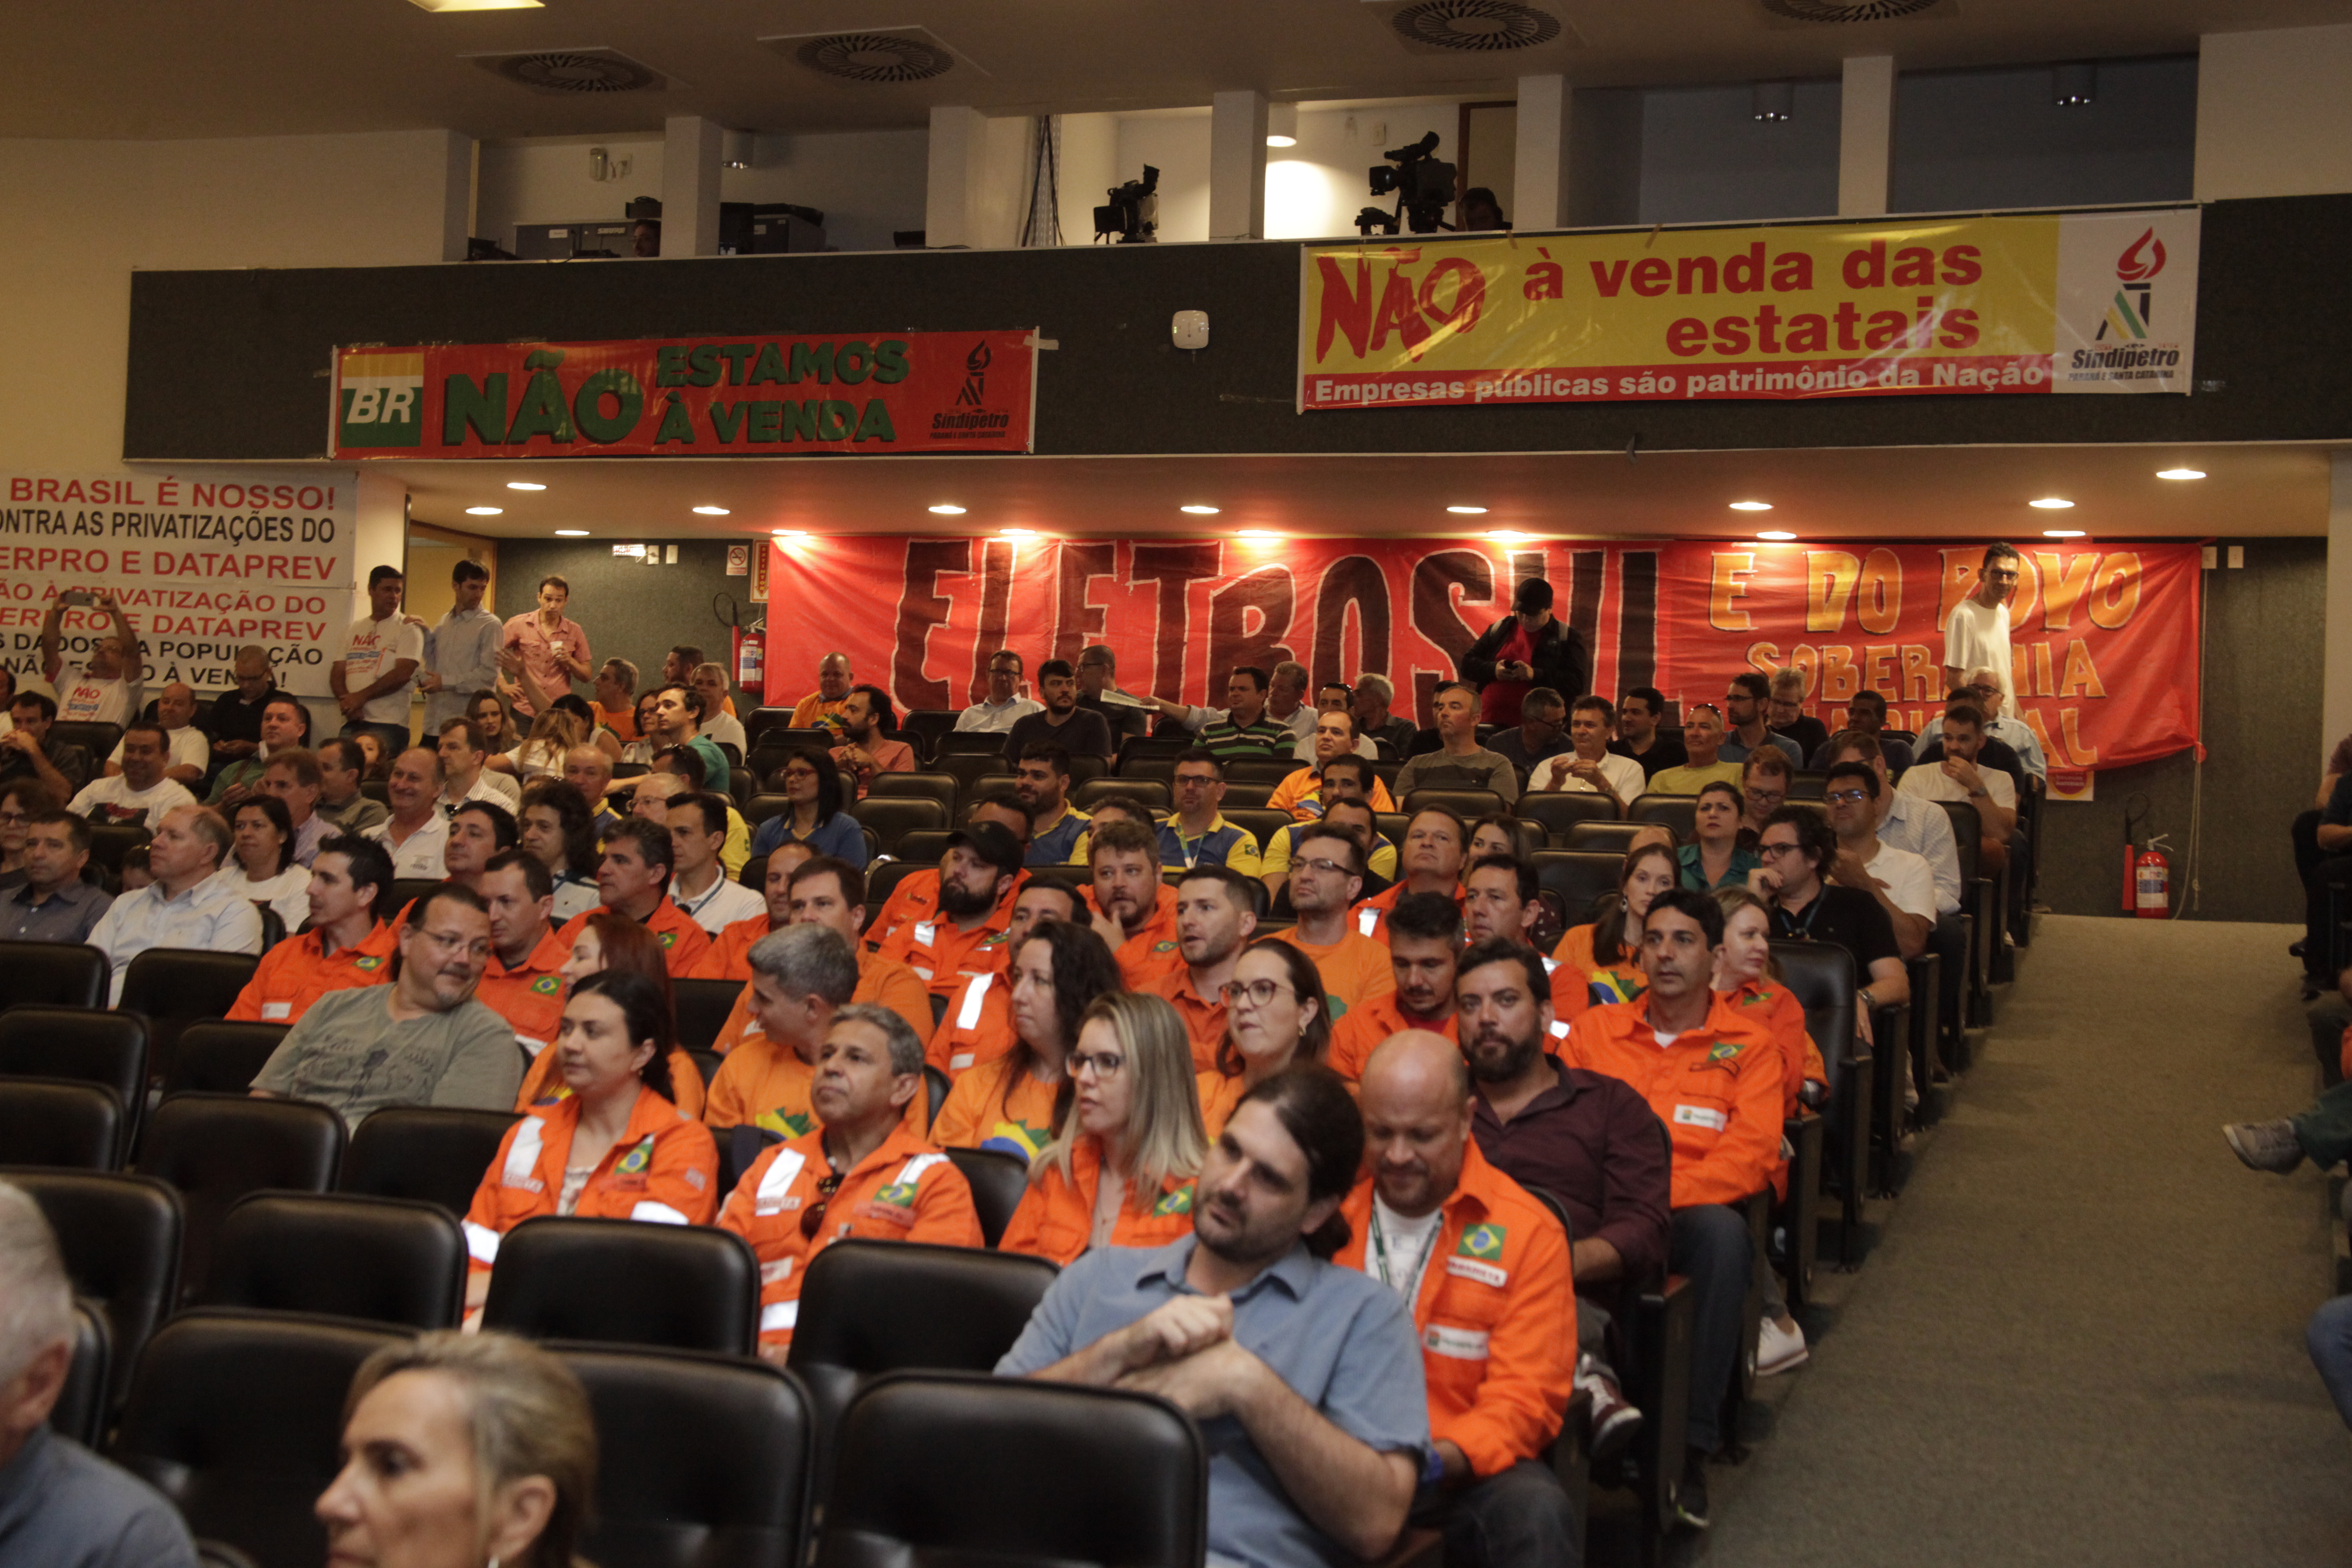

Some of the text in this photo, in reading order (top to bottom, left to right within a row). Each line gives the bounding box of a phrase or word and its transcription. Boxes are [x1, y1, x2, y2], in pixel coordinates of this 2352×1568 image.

[1316, 238, 1982, 364] NÃO à venda das
[1666, 296, 1980, 356] estatais
[655, 340, 910, 388] ESTAMOS
[2072, 348, 2180, 369] Sindipetro
[442, 349, 644, 446] NÃO
[1315, 362, 2043, 405] Empresas públicas são patrimônio da Nação
[346, 386, 415, 424] BR
[654, 391, 897, 445] À VENDA
[932, 413, 1009, 430] Sindipetro
[10, 475, 335, 511] BRASIL É NOSSO!
[72, 511, 104, 536] AS
[111, 510, 293, 547] PRIVATIZAÇÕES
[301, 517, 335, 543] DO
[121, 550, 141, 574] E
[154, 551, 337, 580] DATAPREV
[285, 596, 326, 615] DO
[1710, 551, 1759, 633] E
[1802, 547, 1902, 635] DO
[0, 607, 327, 641] ERRO E DATAPREV
[5, 654, 45, 675] NÃ
[162, 661, 181, 683] À
